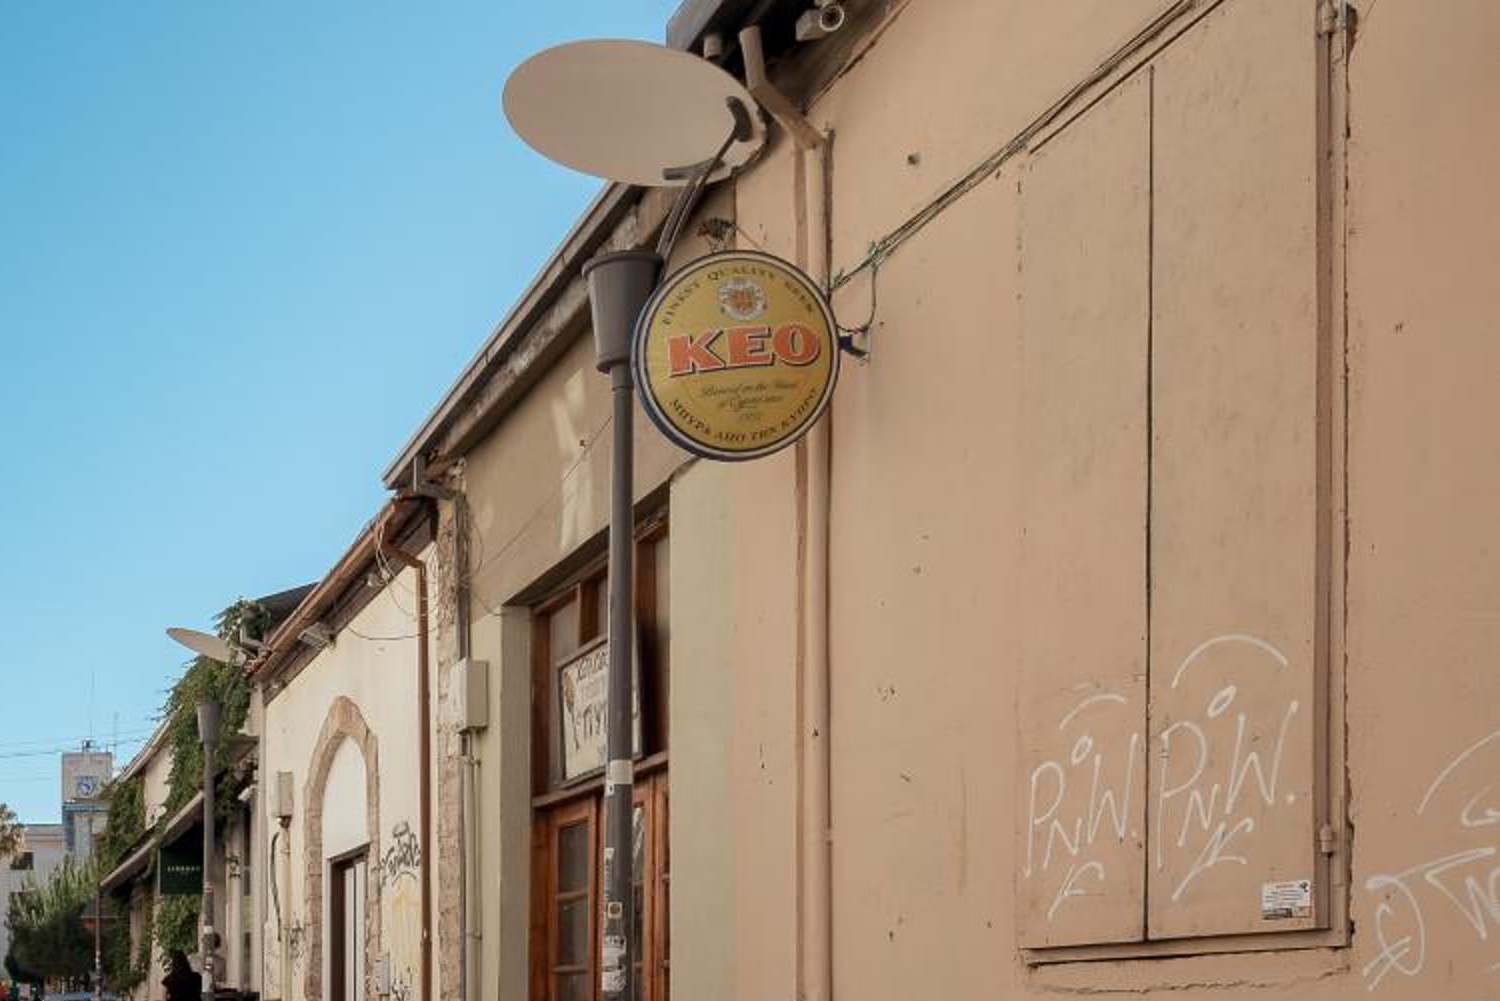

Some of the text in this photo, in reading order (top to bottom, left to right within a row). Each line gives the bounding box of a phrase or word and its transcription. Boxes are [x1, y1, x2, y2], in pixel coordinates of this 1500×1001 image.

[662, 280, 700, 326] FINEST
[707, 266, 775, 281] QUALITY
[668, 323, 822, 376] KEO
